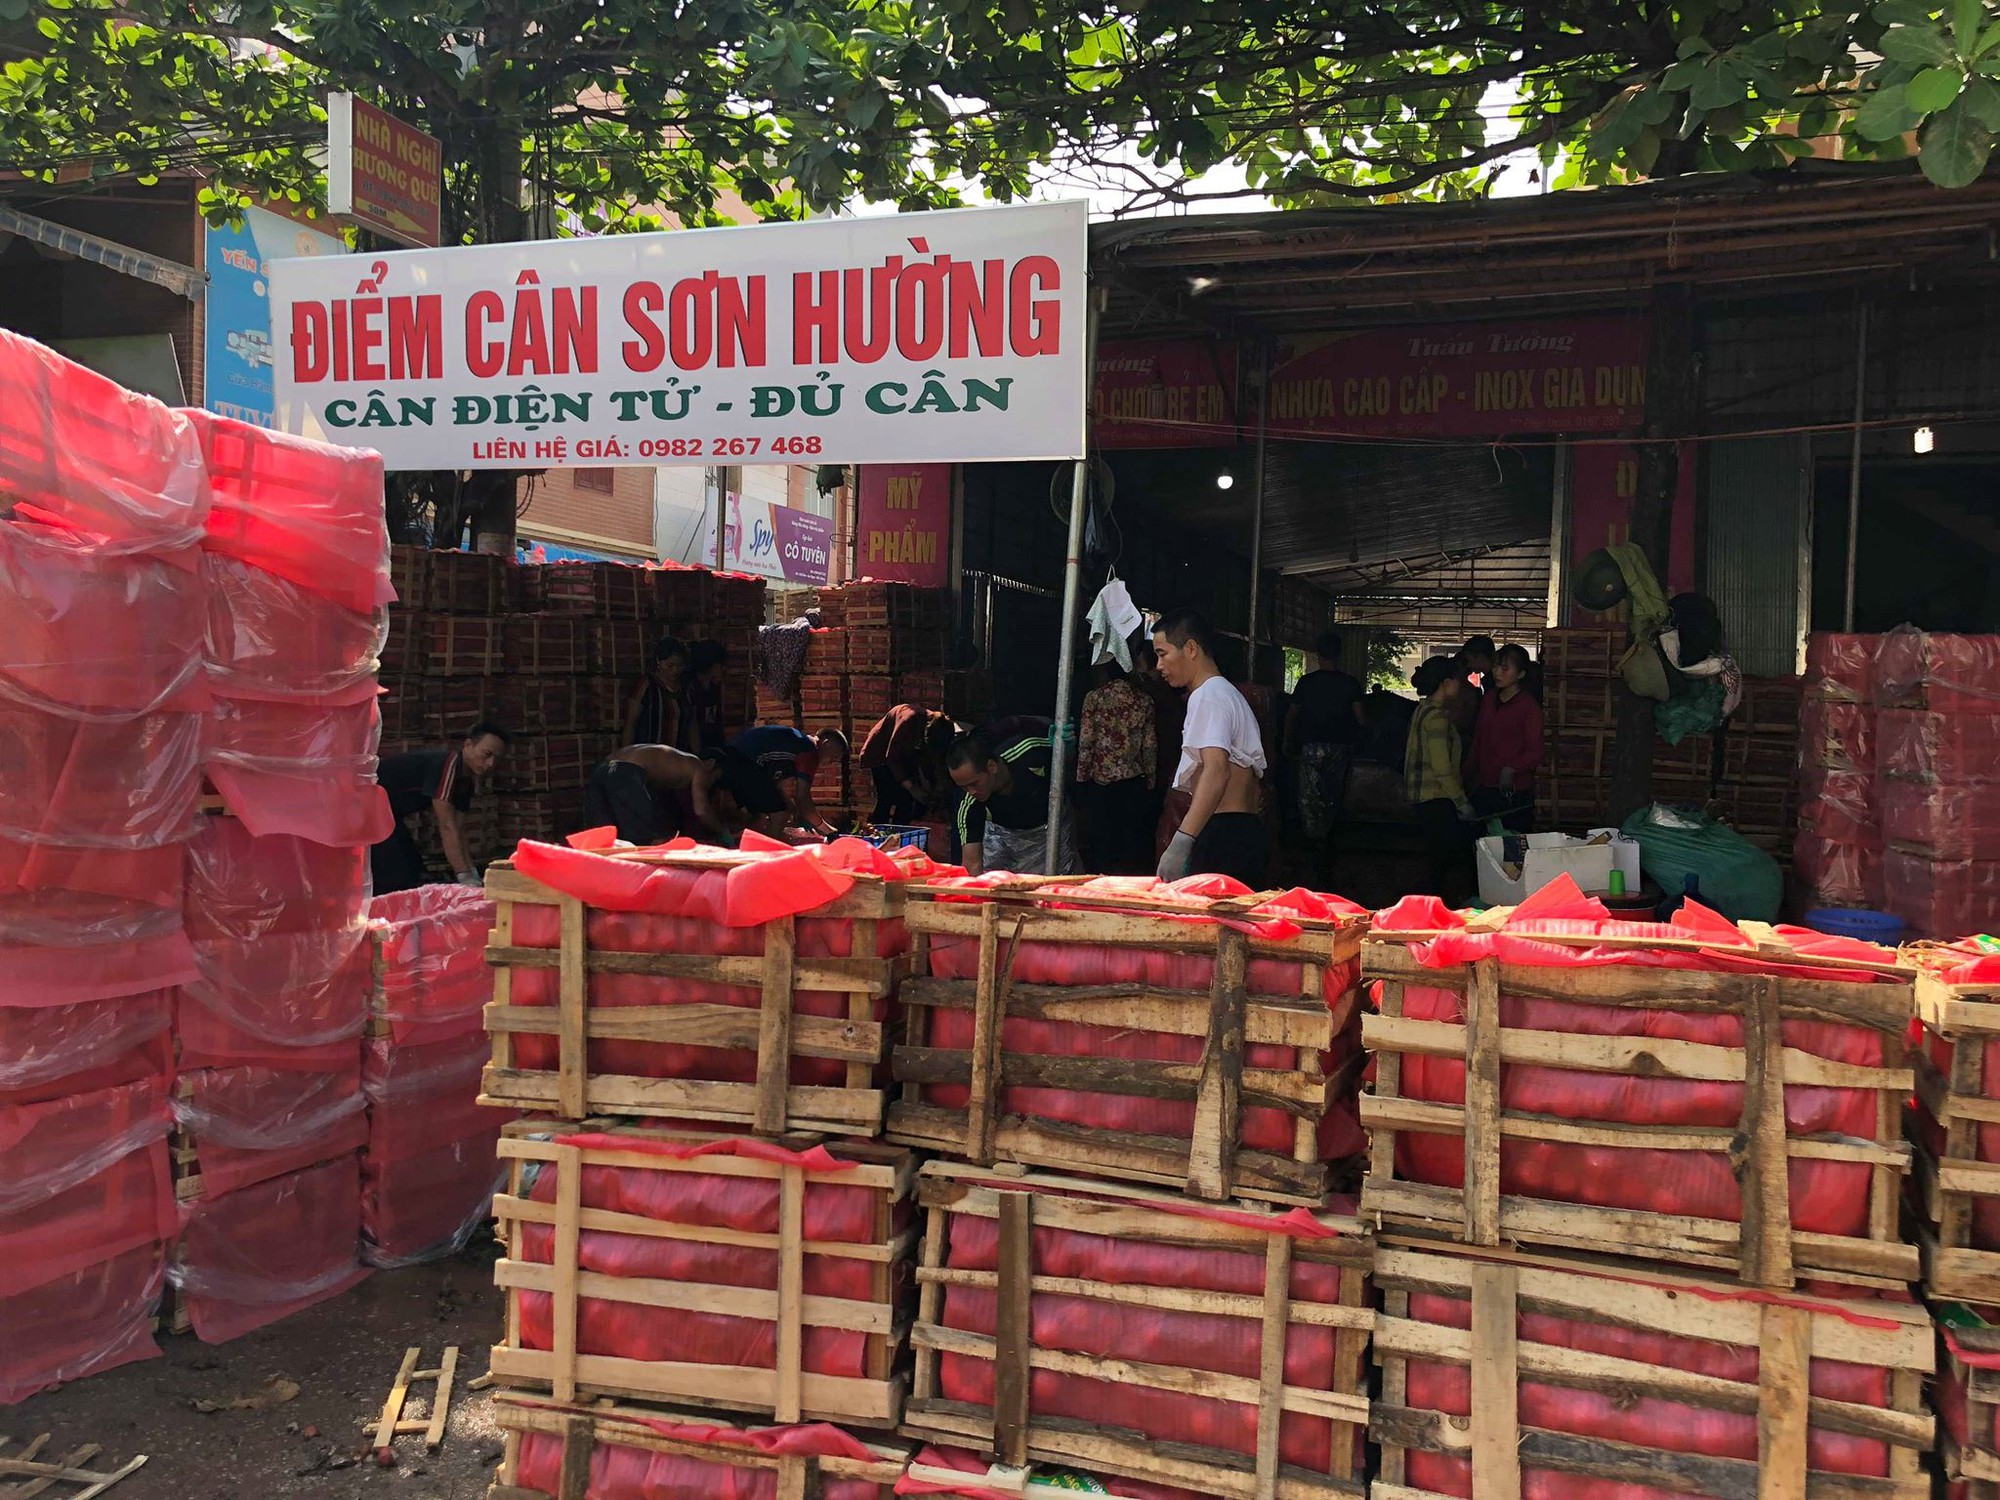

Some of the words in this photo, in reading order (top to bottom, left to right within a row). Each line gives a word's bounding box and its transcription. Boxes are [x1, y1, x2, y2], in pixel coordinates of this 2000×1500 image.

[356, 110, 391, 152] NHÀ
[221, 246, 257, 273] YẾN
[290, 260, 443, 383] ĐIỂM
[465, 269, 598, 378] CÂN
[621, 270, 767, 373] SƠN
[792, 236, 1061, 365] HƯỜNG
[324, 389, 436, 428] CÂN
[452, 384, 593, 431] ĐIỆN
[610, 376, 703, 421] TỬ
[716, 402, 733, 412] -
[750, 371, 845, 418] ĐỦ
[865, 369, 1014, 413] CÂN
[1196, 384, 1225, 422] EM
[1270, 375, 1335, 428] NHỰA
[1343, 376, 1391, 416] CAO
[1399, 361, 1448, 415] CẤP
[1474, 369, 1537, 412] INOX
[1543, 367, 1586, 408] GIA
[1595, 364, 1647, 415] DỤN
[473, 436, 527, 459] LIÊN
[535, 435, 568, 463] HỆ
[576, 434, 630, 458] GIÁ:
[638, 437, 703, 457] 0982
[711, 437, 761, 456] 267
[770, 436, 822, 455] 468
[886, 471, 923, 510] MỸ
[749, 519, 774, 556] Spy
[784, 540, 799, 560] CÔ
[801, 545, 826, 565] TUYÊN
[868, 519, 937, 565] PHẨM
